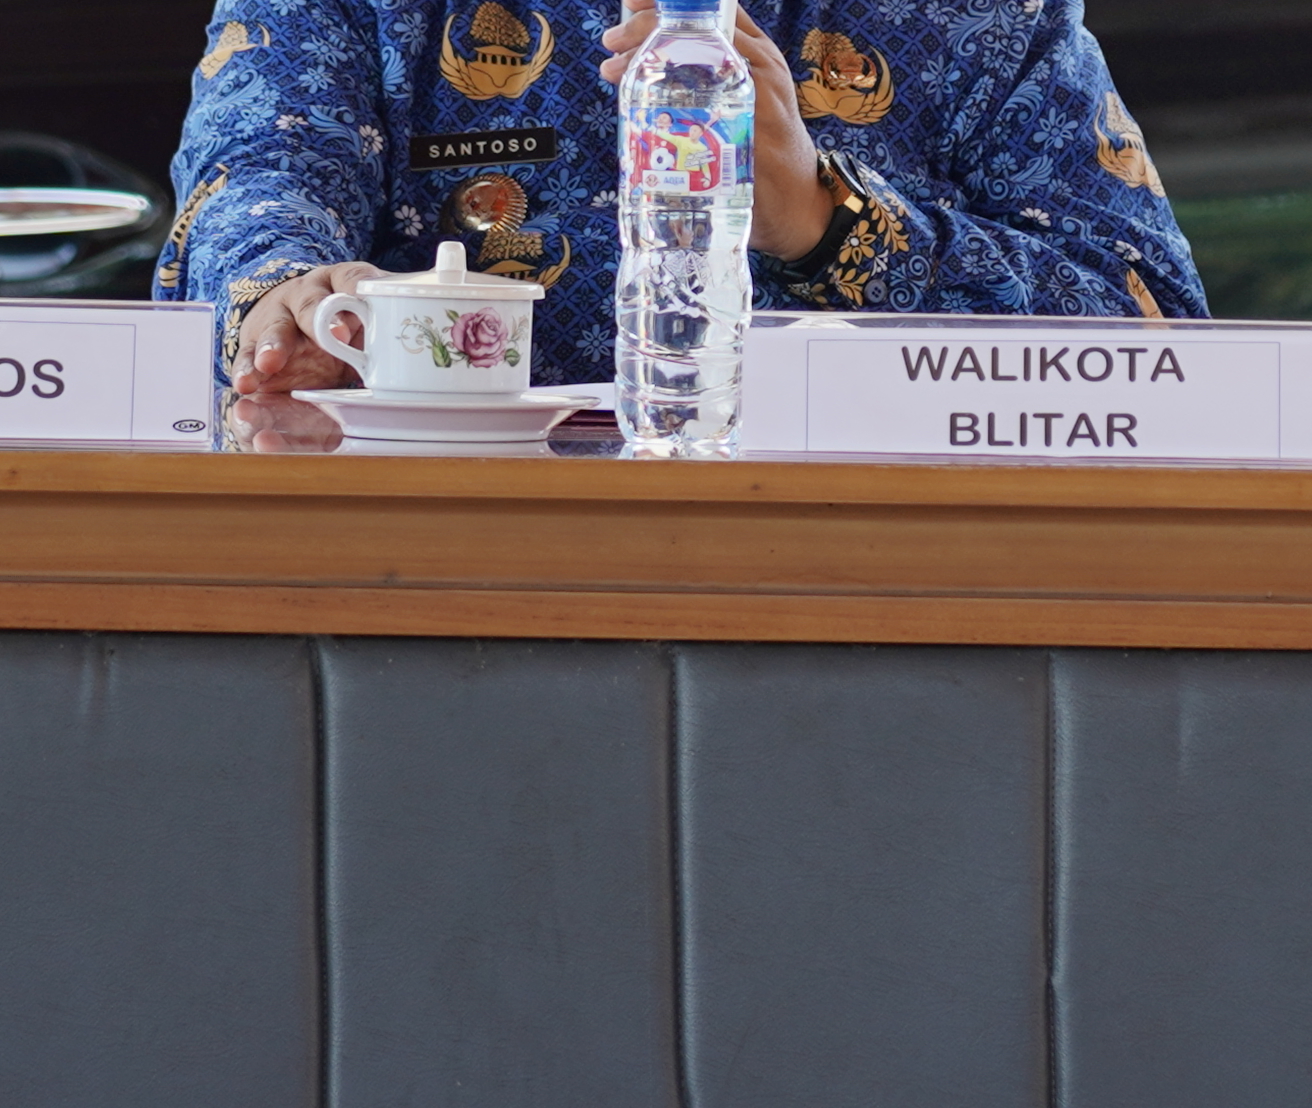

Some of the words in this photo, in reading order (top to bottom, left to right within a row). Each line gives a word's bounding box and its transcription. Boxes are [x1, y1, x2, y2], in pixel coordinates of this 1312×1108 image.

[428, 137, 538, 159] SANTOSO
[901, 346, 1185, 383] WALIKOTA
[949, 412, 1138, 448] BLITAR
